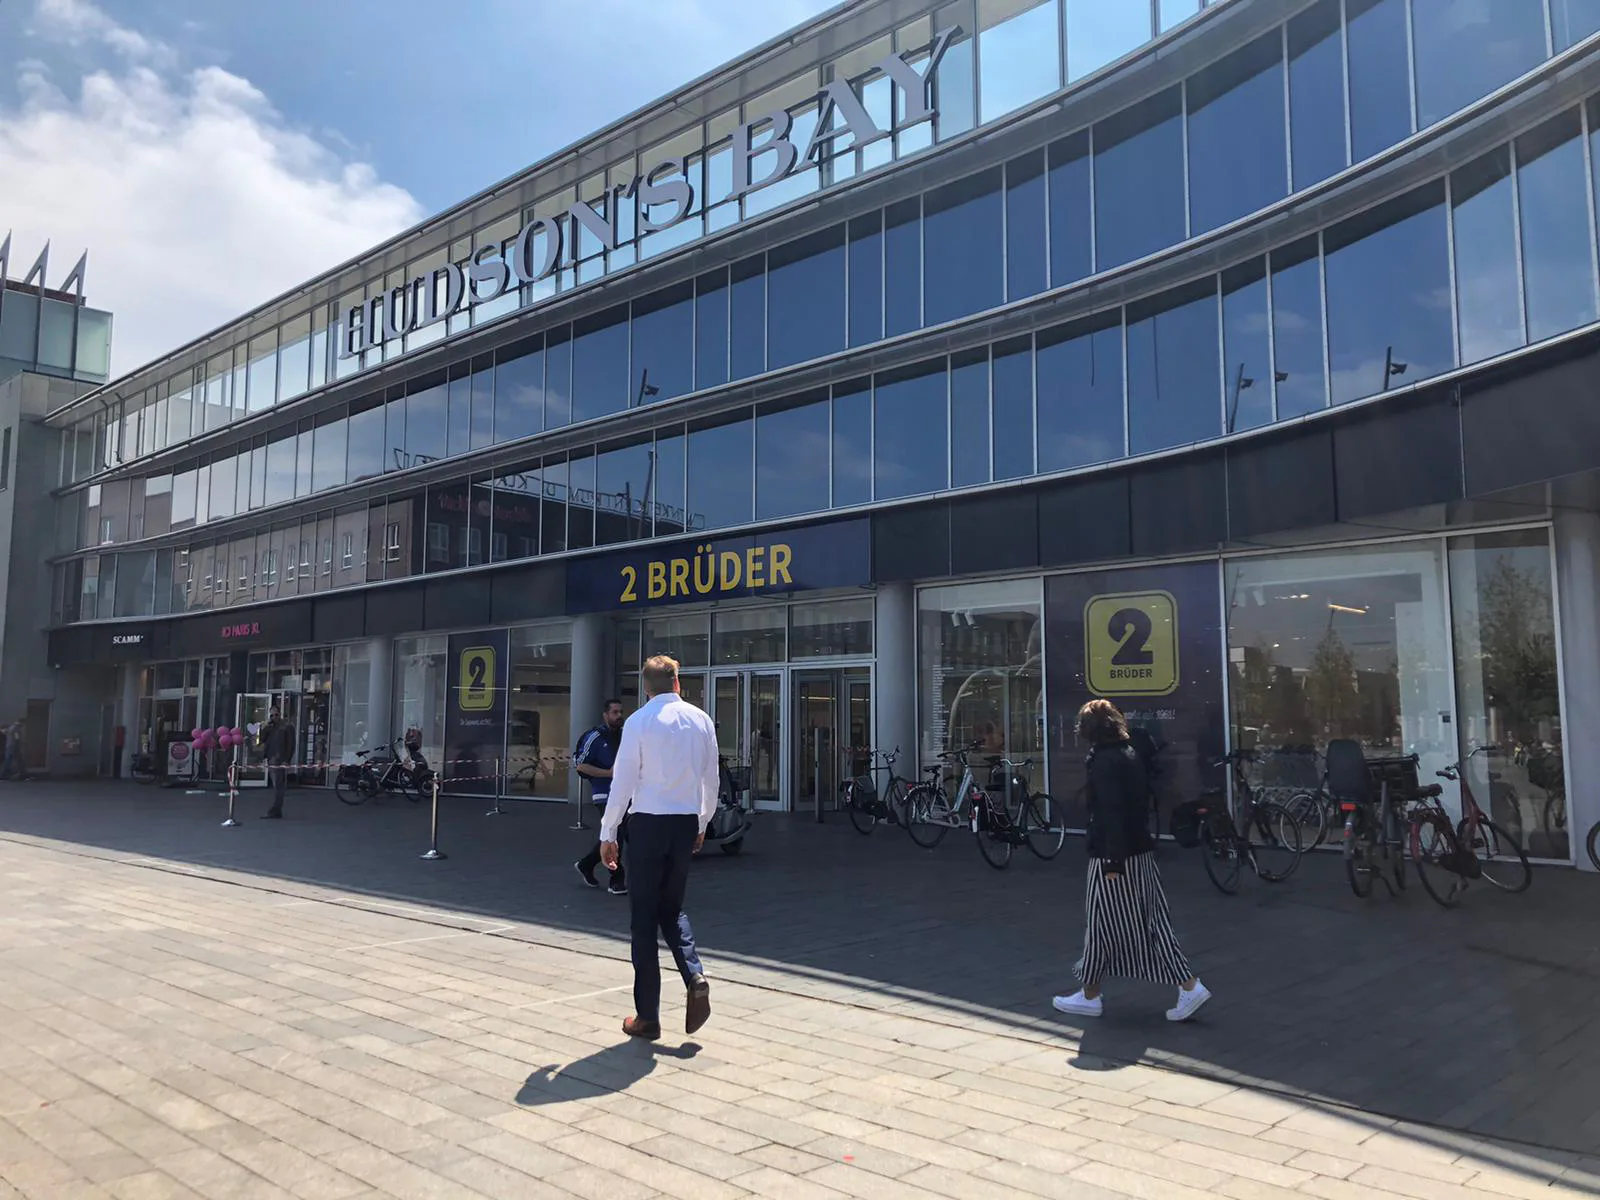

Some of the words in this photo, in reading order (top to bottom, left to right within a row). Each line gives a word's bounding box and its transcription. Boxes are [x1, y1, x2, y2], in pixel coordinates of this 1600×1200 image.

[338, 156, 694, 360] HUDSON'S
[725, 24, 964, 200] BAY
[620, 566, 637, 602] 2
[648, 543, 793, 599] BRÜDER
[1108, 608, 1153, 665] 2
[469, 656, 486, 691] 2
[1109, 667, 1153, 679] BRÜDER
